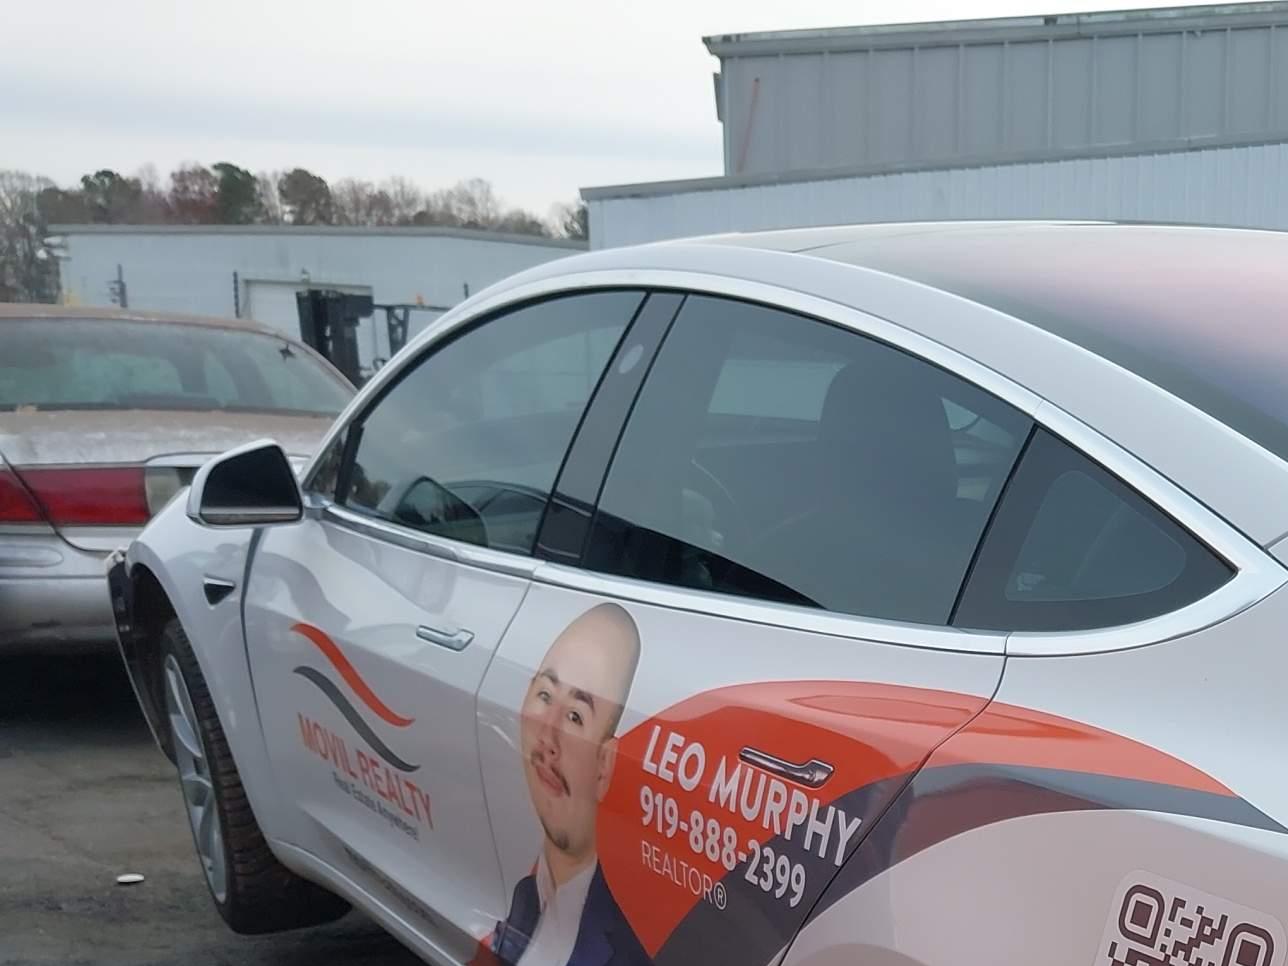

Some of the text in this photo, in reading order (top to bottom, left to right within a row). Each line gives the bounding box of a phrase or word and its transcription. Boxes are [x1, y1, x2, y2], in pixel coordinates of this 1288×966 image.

[298, 712, 358, 779] MOVIL
[356, 749, 434, 830] REALTY
[642, 725, 862, 867] LEO MURPHY
[640, 785, 806, 908] 919-888-2399
